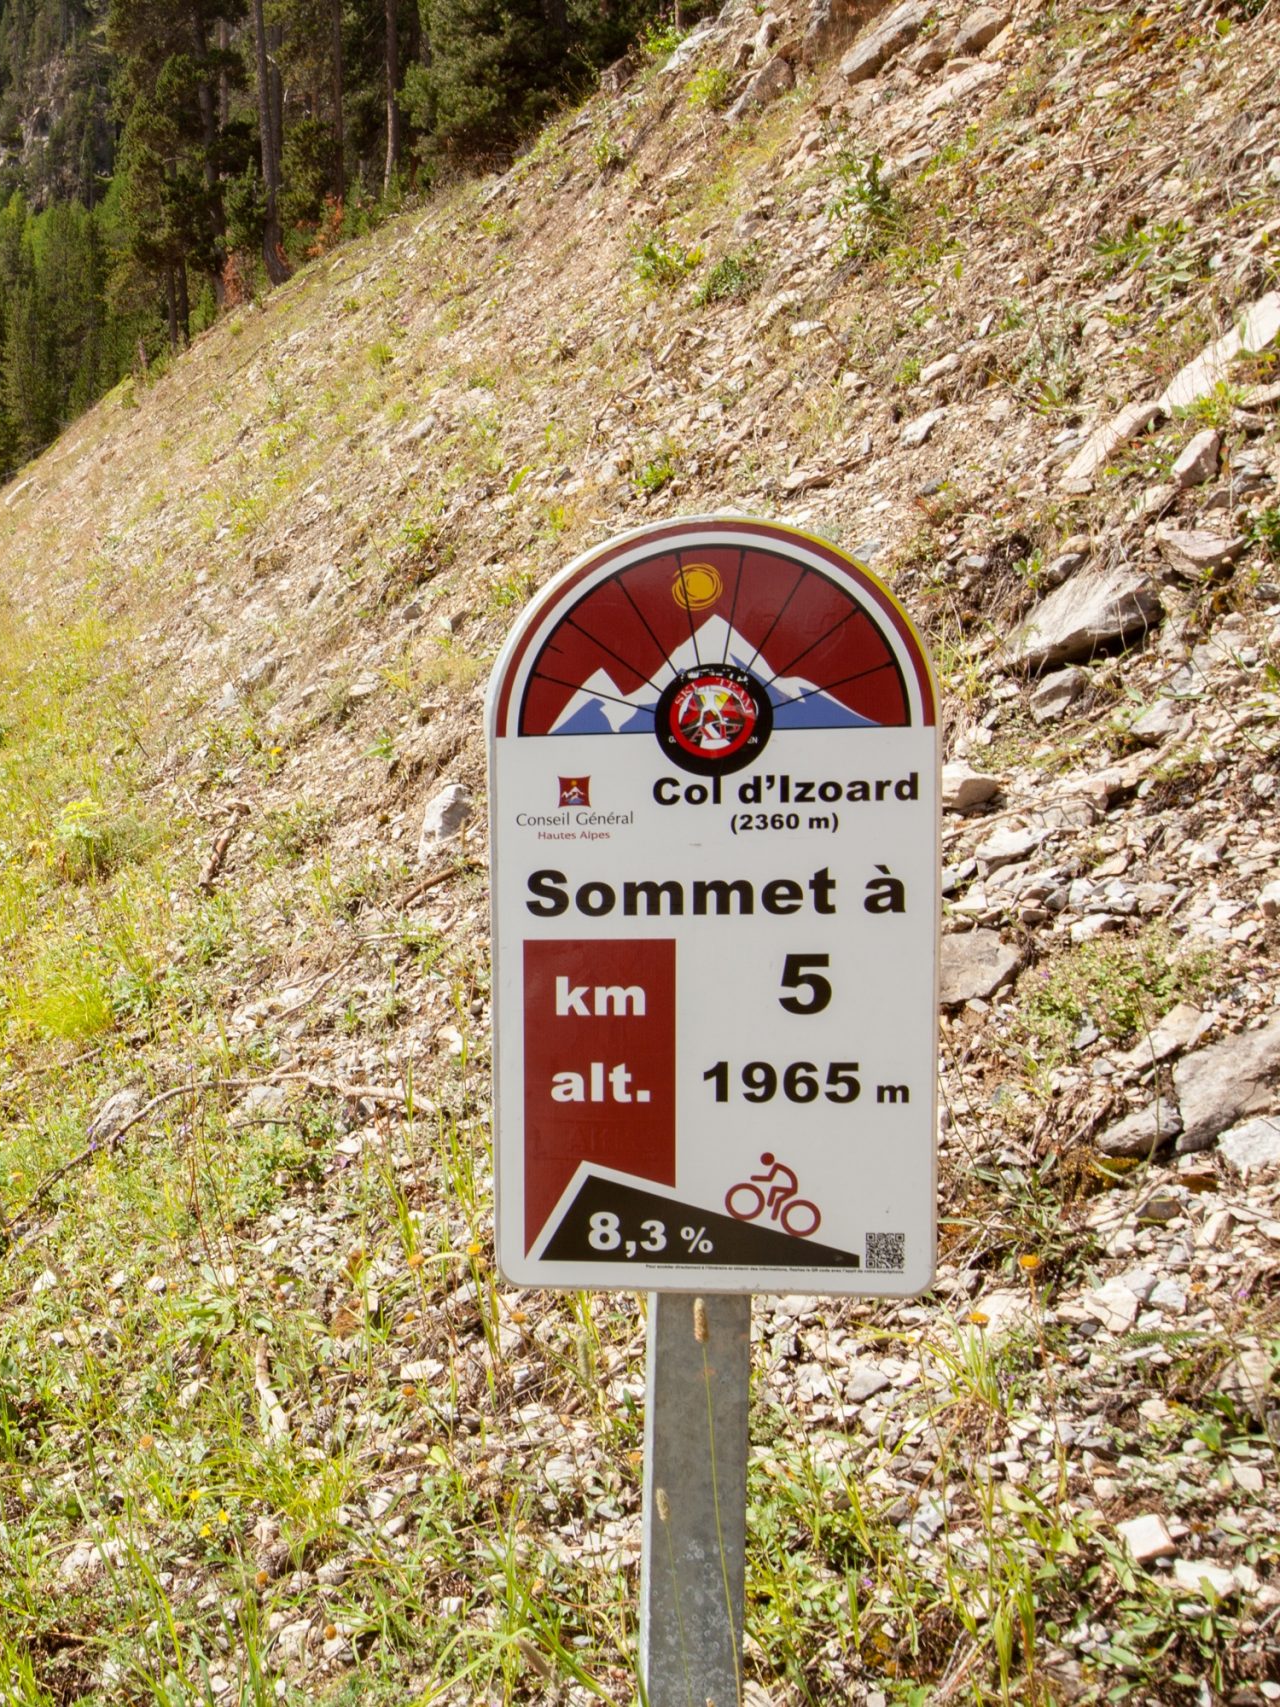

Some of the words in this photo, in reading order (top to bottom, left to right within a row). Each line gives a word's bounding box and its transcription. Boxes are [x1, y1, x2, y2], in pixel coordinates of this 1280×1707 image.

[674, 681, 698, 705] SKI
[653, 776, 722, 806] Col
[738, 771, 919, 805] d'Izoard
[516, 811, 570, 827] Conseil
[576, 810, 634, 826] Général
[537, 831, 577, 840] Hautes
[580, 830, 611, 841] Alpes
[730, 813, 800, 835] (2360
[808, 812, 839, 834] m)
[526, 867, 837, 918] Sommet
[864, 865, 906, 914] à
[555, 975, 646, 1016] km
[778, 953, 832, 1015] 5
[551, 1063, 651, 1103] alt.
[703, 1061, 861, 1104] 1965
[876, 1084, 910, 1104] m
[588, 1211, 667, 1258] 8,3
[680, 1226, 714, 1254] %
